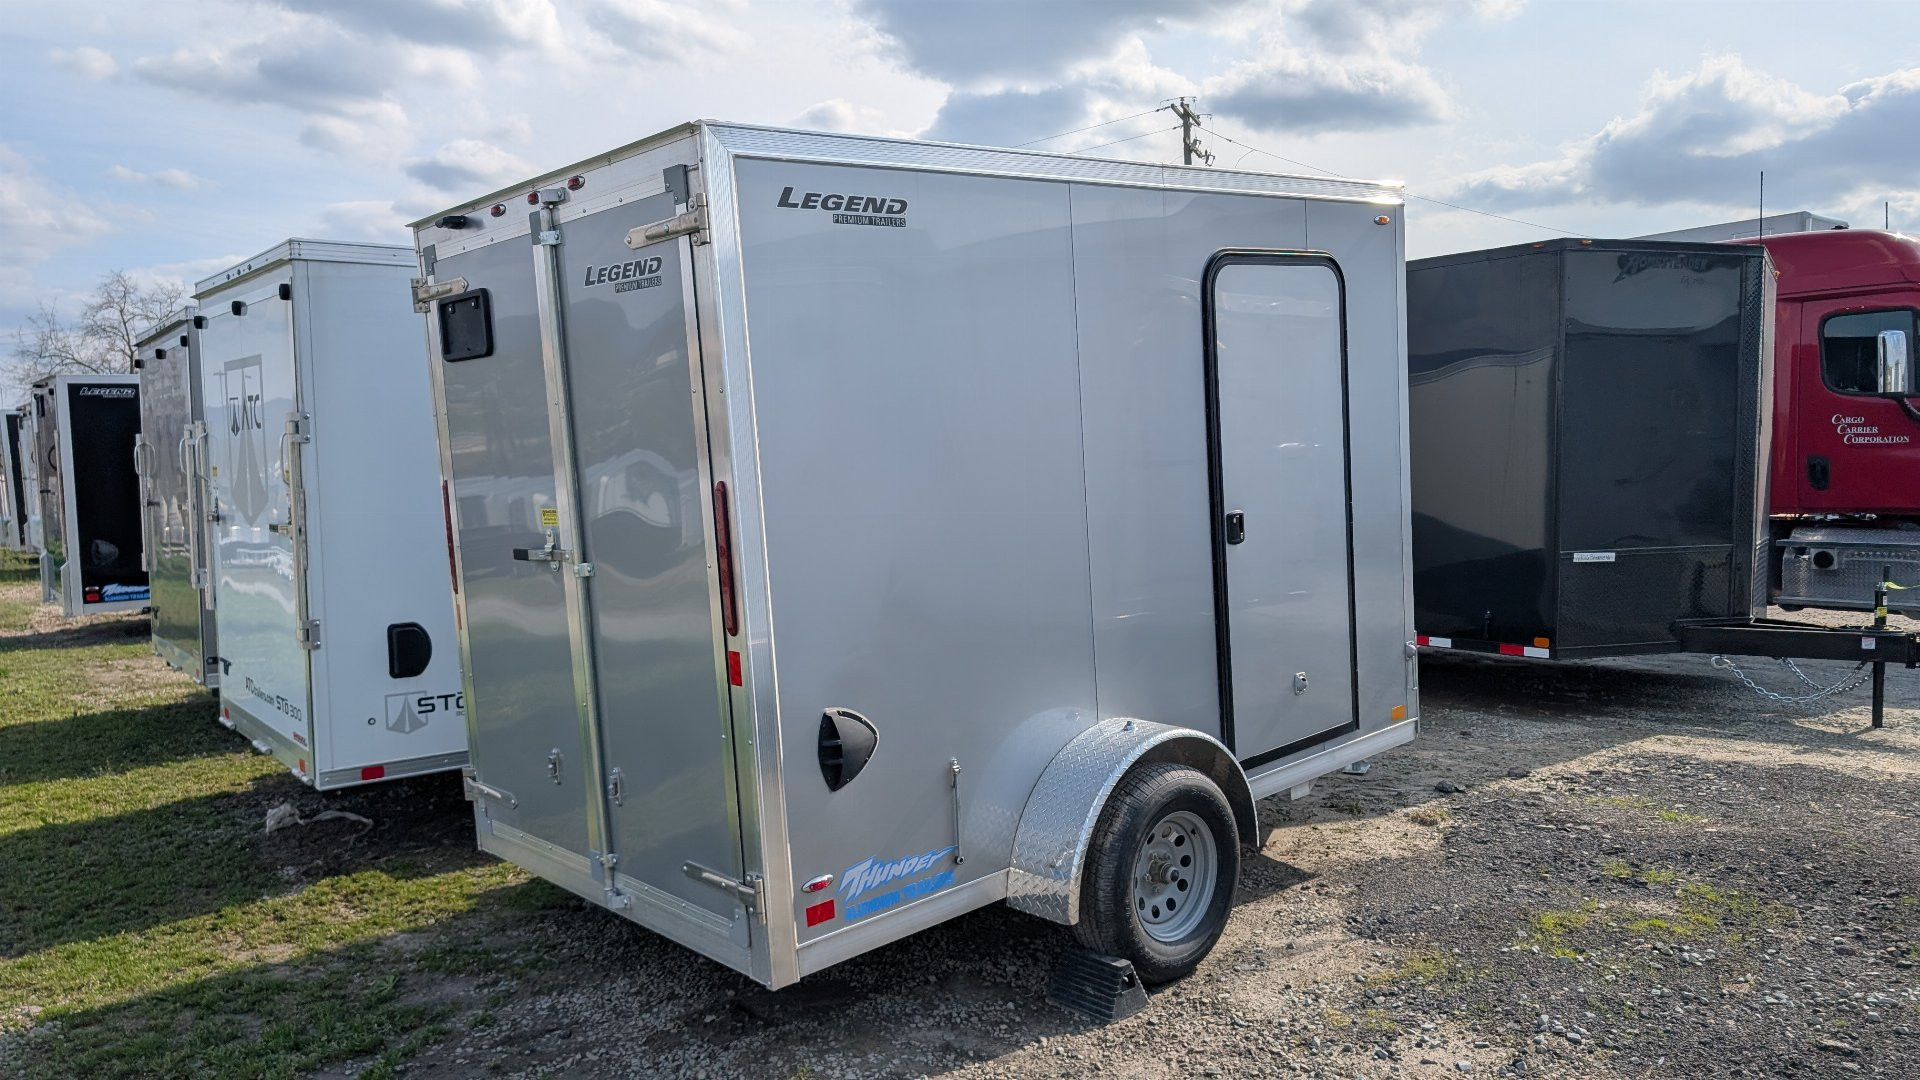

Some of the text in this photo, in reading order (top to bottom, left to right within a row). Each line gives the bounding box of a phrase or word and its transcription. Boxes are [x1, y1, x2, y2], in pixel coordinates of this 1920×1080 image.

[776, 186, 908, 215] LEGEND
[833, 214, 906, 228] PREMIUM TRAILERS
[584, 256, 662, 287] LEGEND
[241, 394, 261, 431] ATC
[1831, 413, 1865, 424] CARGO
[1837, 424, 1878, 434] CARRIER
[1843, 434, 1910, 444] CORPORATION
[838, 847, 957, 905] THUNDER
